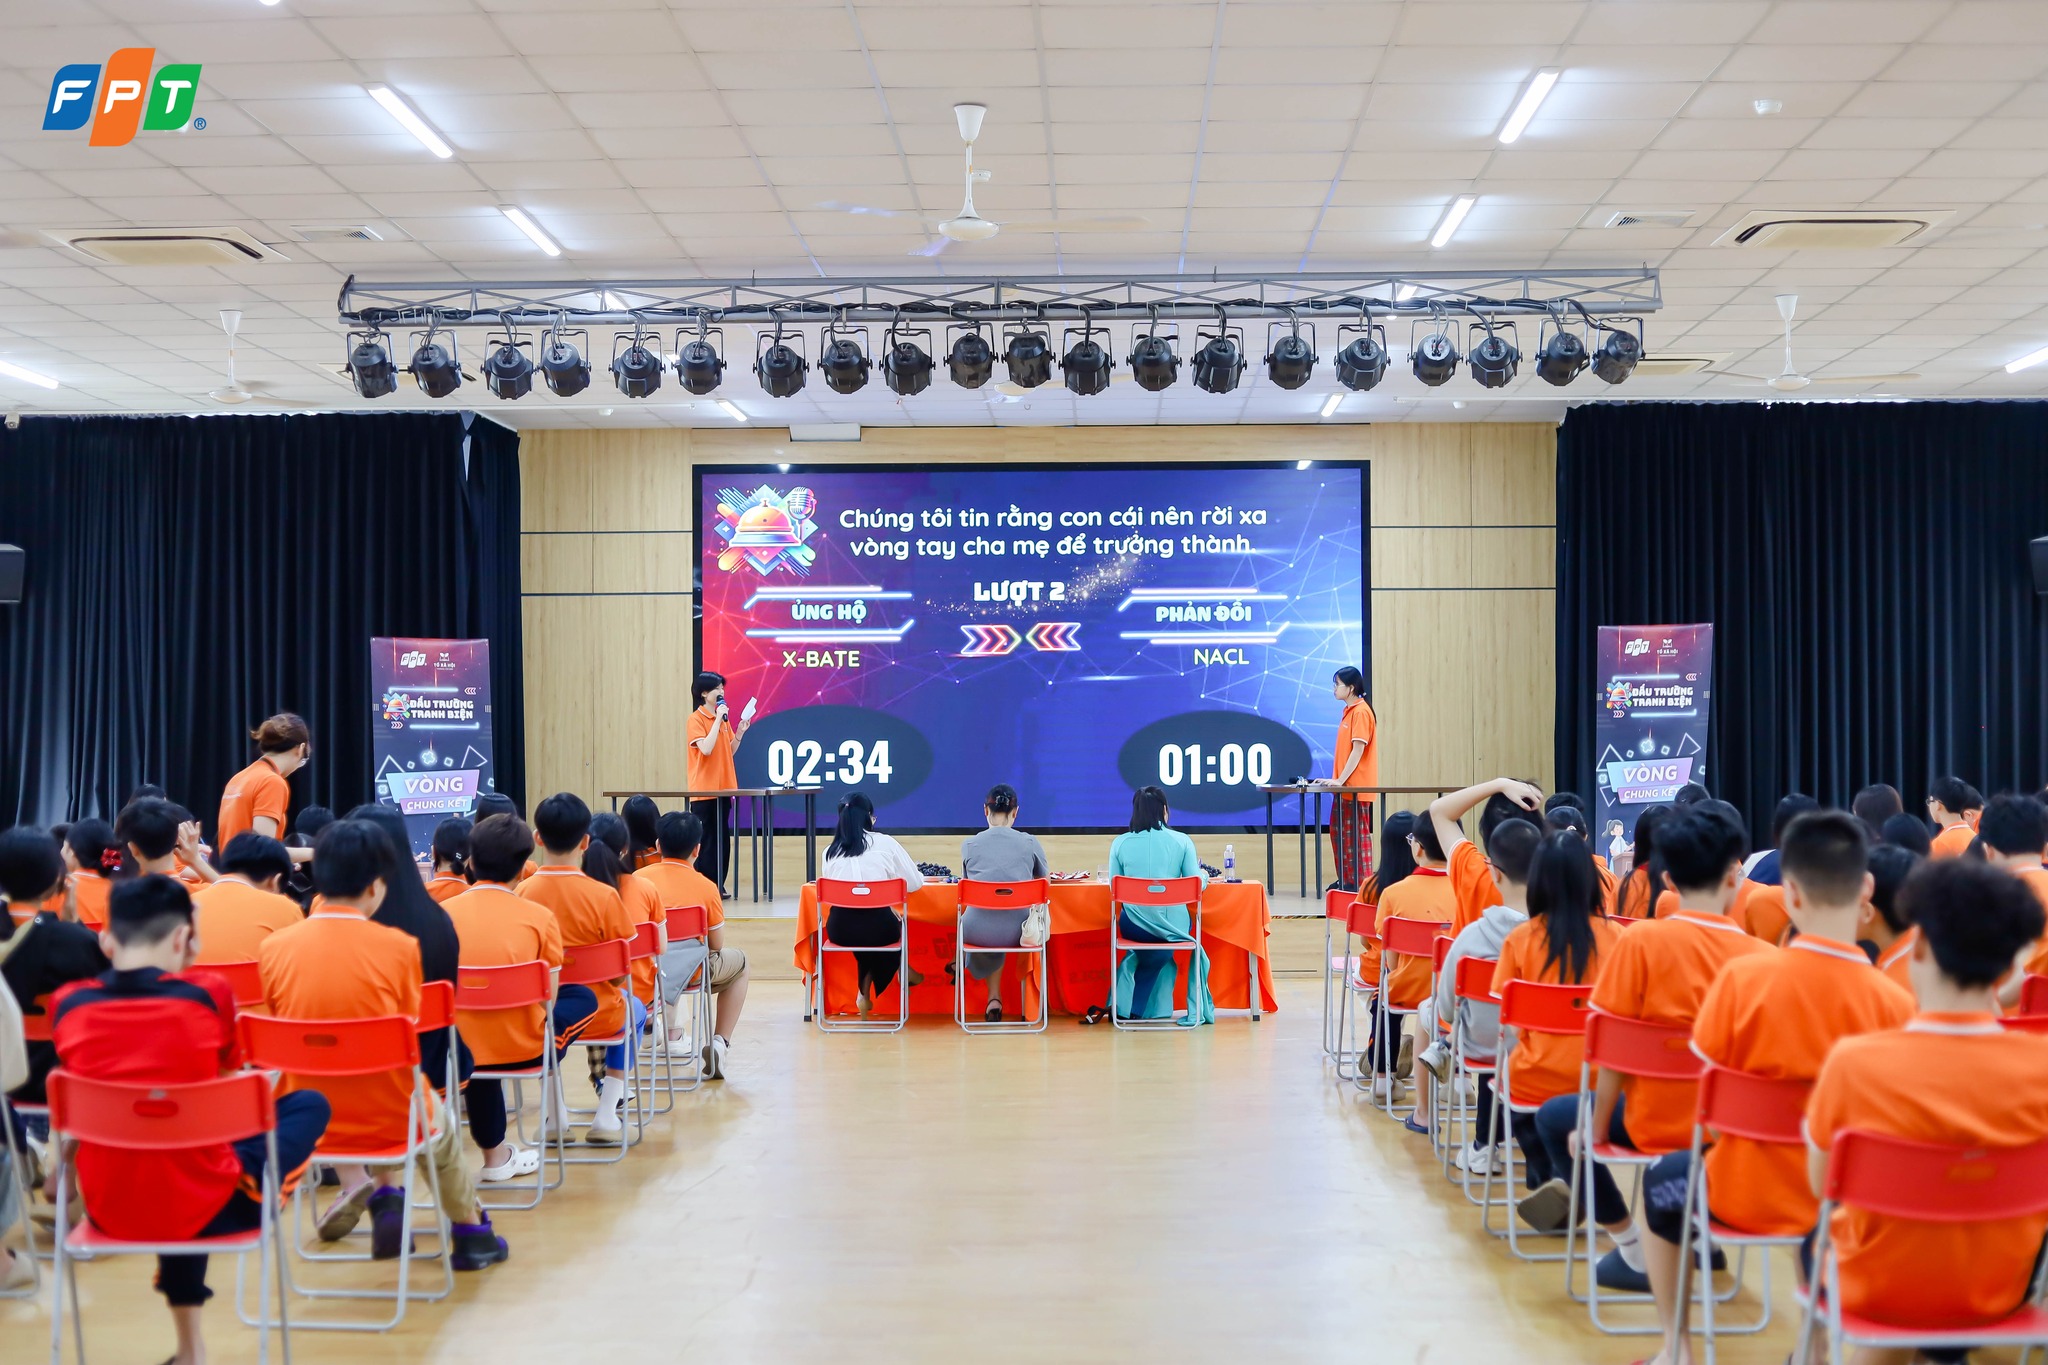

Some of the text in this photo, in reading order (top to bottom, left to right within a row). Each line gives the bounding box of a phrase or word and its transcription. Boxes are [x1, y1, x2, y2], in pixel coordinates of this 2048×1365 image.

[839, 504, 1267, 532] Chúng tôi tin rằng con cái nên rời xa
[850, 533, 1256, 560] vòng tay cha mẹ để trưởng thành.
[974, 580, 1065, 606] LƯỢT 2
[791, 599, 867, 624] ỦNG HỘ
[1156, 601, 1211, 622] PHẢN
[782, 650, 860, 667] X-BATE
[1194, 648, 1250, 665] NACL
[1654, 685, 1693, 696] TRƯỜNG
[433, 698, 474, 709] TRƯỜNG
[1632, 695, 1692, 708] TRANH BIỆN
[411, 709, 473, 721] TRANH BIỆN
[768, 740, 893, 785] 02:34
[1159, 743, 1272, 786] 01:00
[1623, 763, 1678, 783] VÒNG
[404, 774, 464, 794] VÒNG
[1624, 789, 1659, 799] CHUNG
[407, 796, 468, 810] CHUNG KẾT
